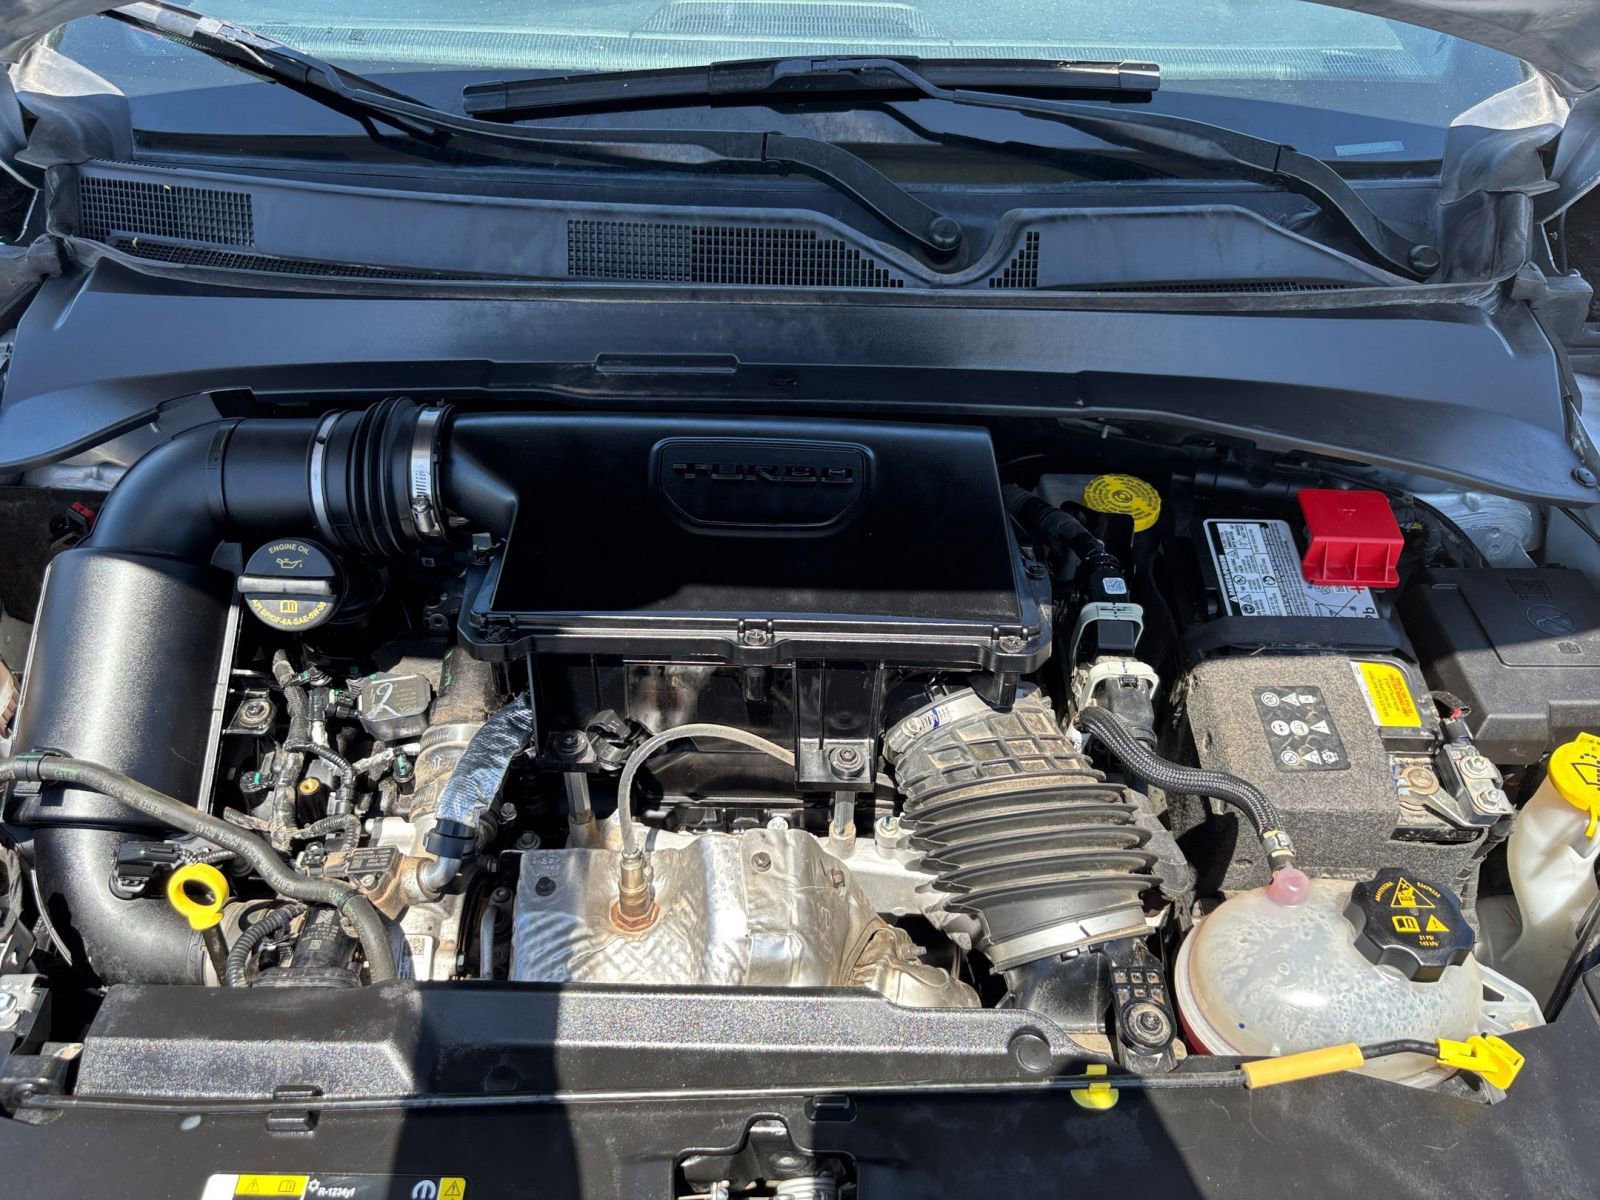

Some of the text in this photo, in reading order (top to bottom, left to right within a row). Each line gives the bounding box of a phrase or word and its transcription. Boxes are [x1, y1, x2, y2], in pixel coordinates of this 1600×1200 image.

[672, 463, 855, 483] TURBO
[268, 544, 311, 556] ENGINE OIL
